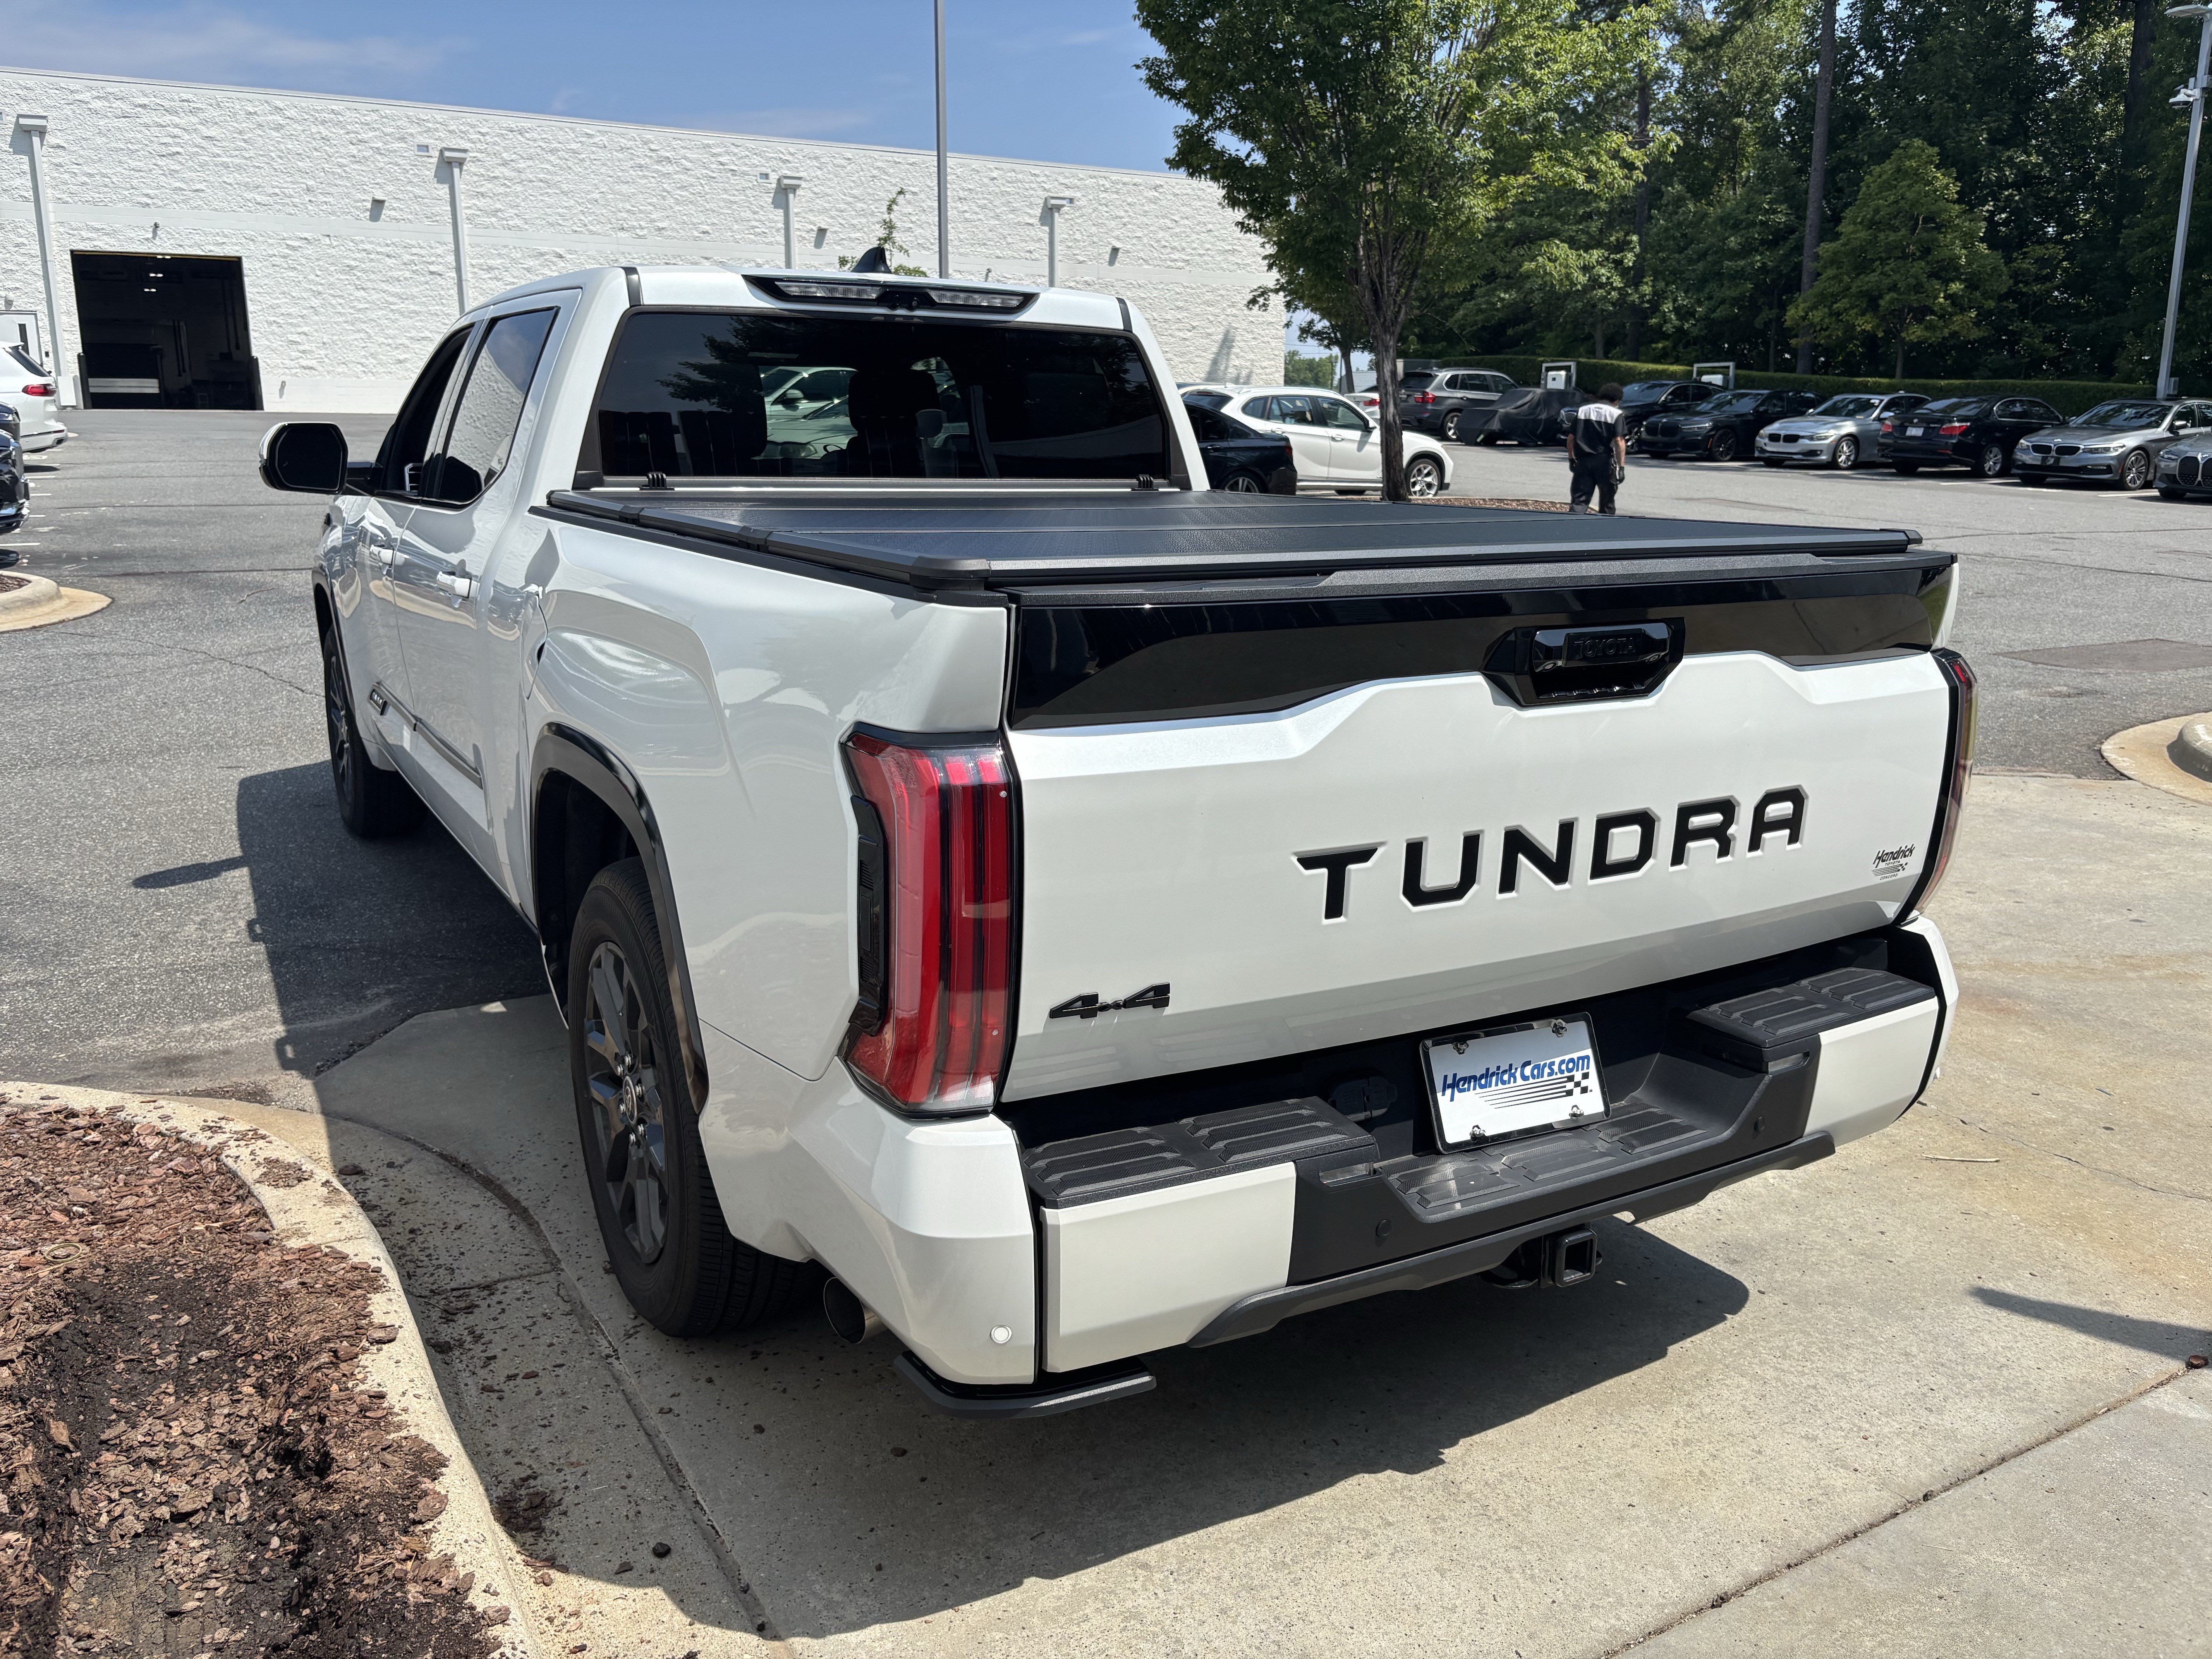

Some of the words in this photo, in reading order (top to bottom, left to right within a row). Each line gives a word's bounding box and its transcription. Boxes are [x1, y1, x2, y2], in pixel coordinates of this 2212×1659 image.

[1573, 637, 1635, 658] TOYOTA
[1294, 787, 1807, 922] TUNDRA
[1873, 844, 1915, 868] Hendrick
